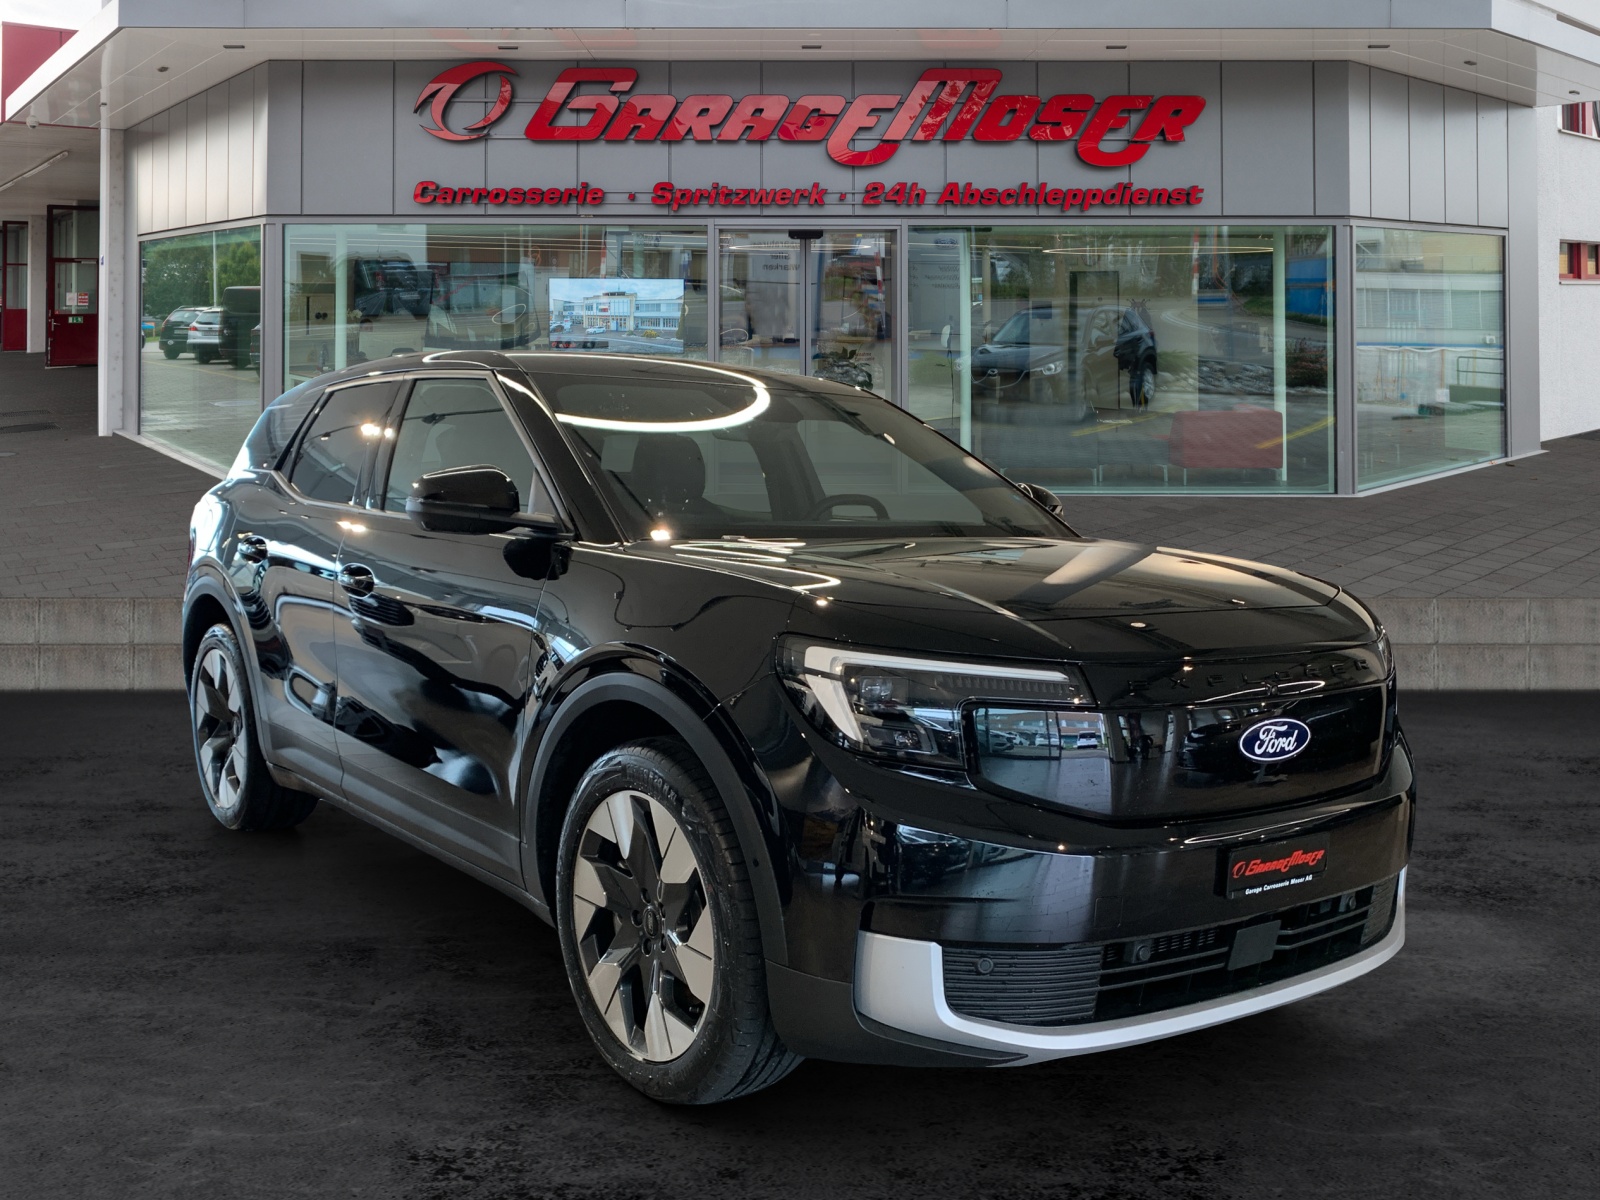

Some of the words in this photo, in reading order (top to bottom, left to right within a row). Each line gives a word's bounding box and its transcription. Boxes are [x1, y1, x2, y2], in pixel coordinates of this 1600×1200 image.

[413, 181, 604, 205] Carrosserie
[651, 181, 828, 211] Spritzwerk
[862, 182, 927, 206] 24h
[937, 181, 1204, 213] Abschleppdienst
[1127, 658, 1370, 694] EXPLORER
[1254, 724, 1298, 755] Ford
[1245, 887, 1262, 895] Garage
